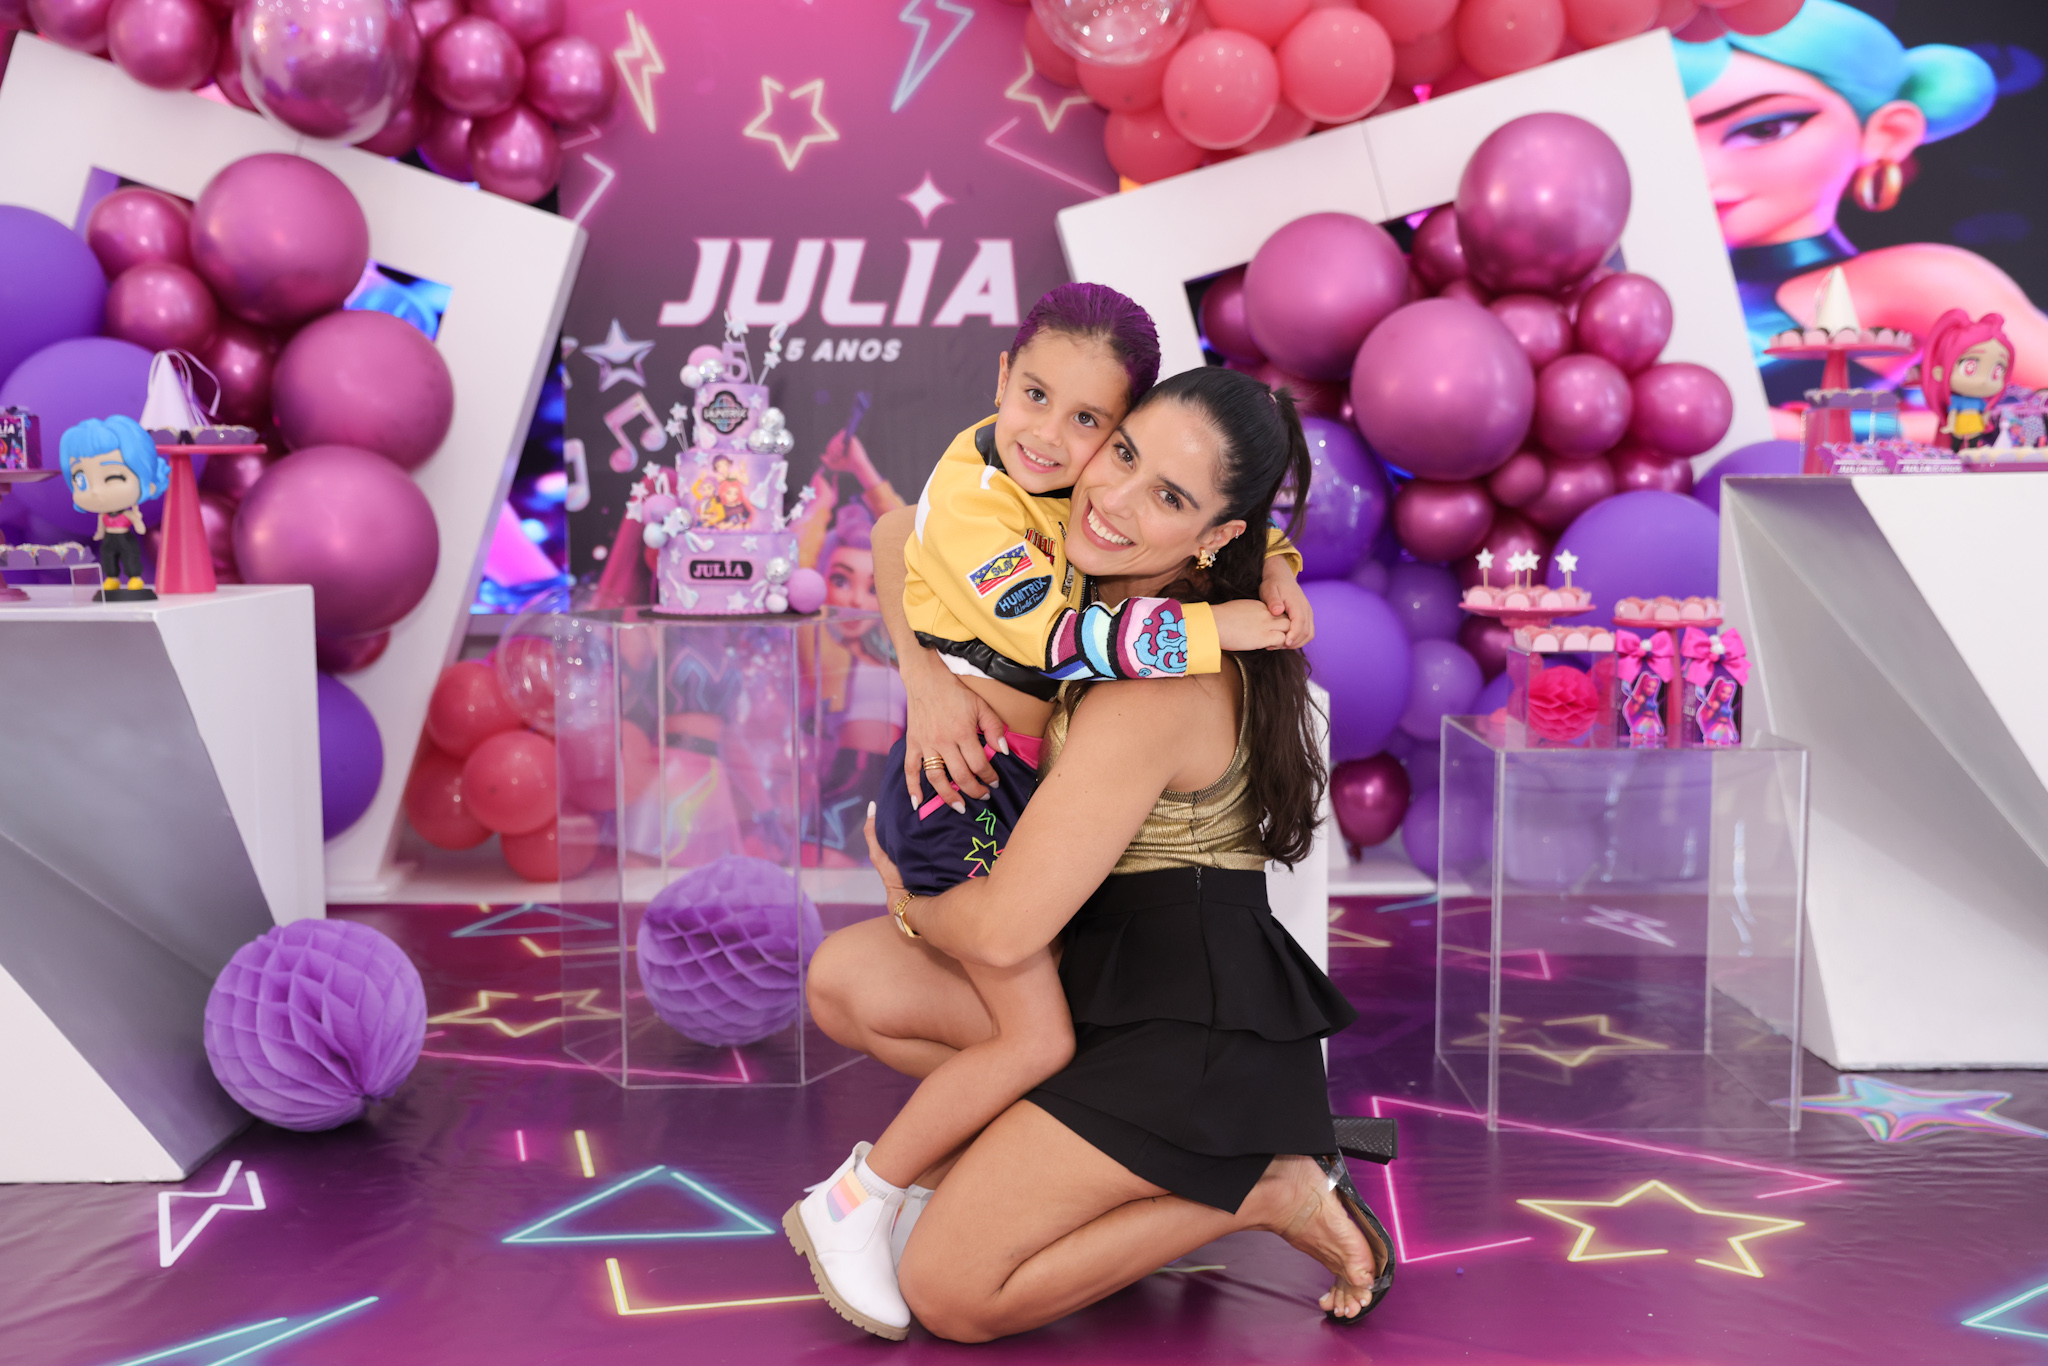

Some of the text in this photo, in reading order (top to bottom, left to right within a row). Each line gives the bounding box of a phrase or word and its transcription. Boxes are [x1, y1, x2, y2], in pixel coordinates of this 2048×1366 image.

[657, 238, 1020, 327] JULIA
[785, 338, 902, 362] 5 ANOS
[693, 559, 745, 578] JULIA
[991, 558, 1014, 576] SLAY
[998, 578, 1048, 612] HUMTRIX
